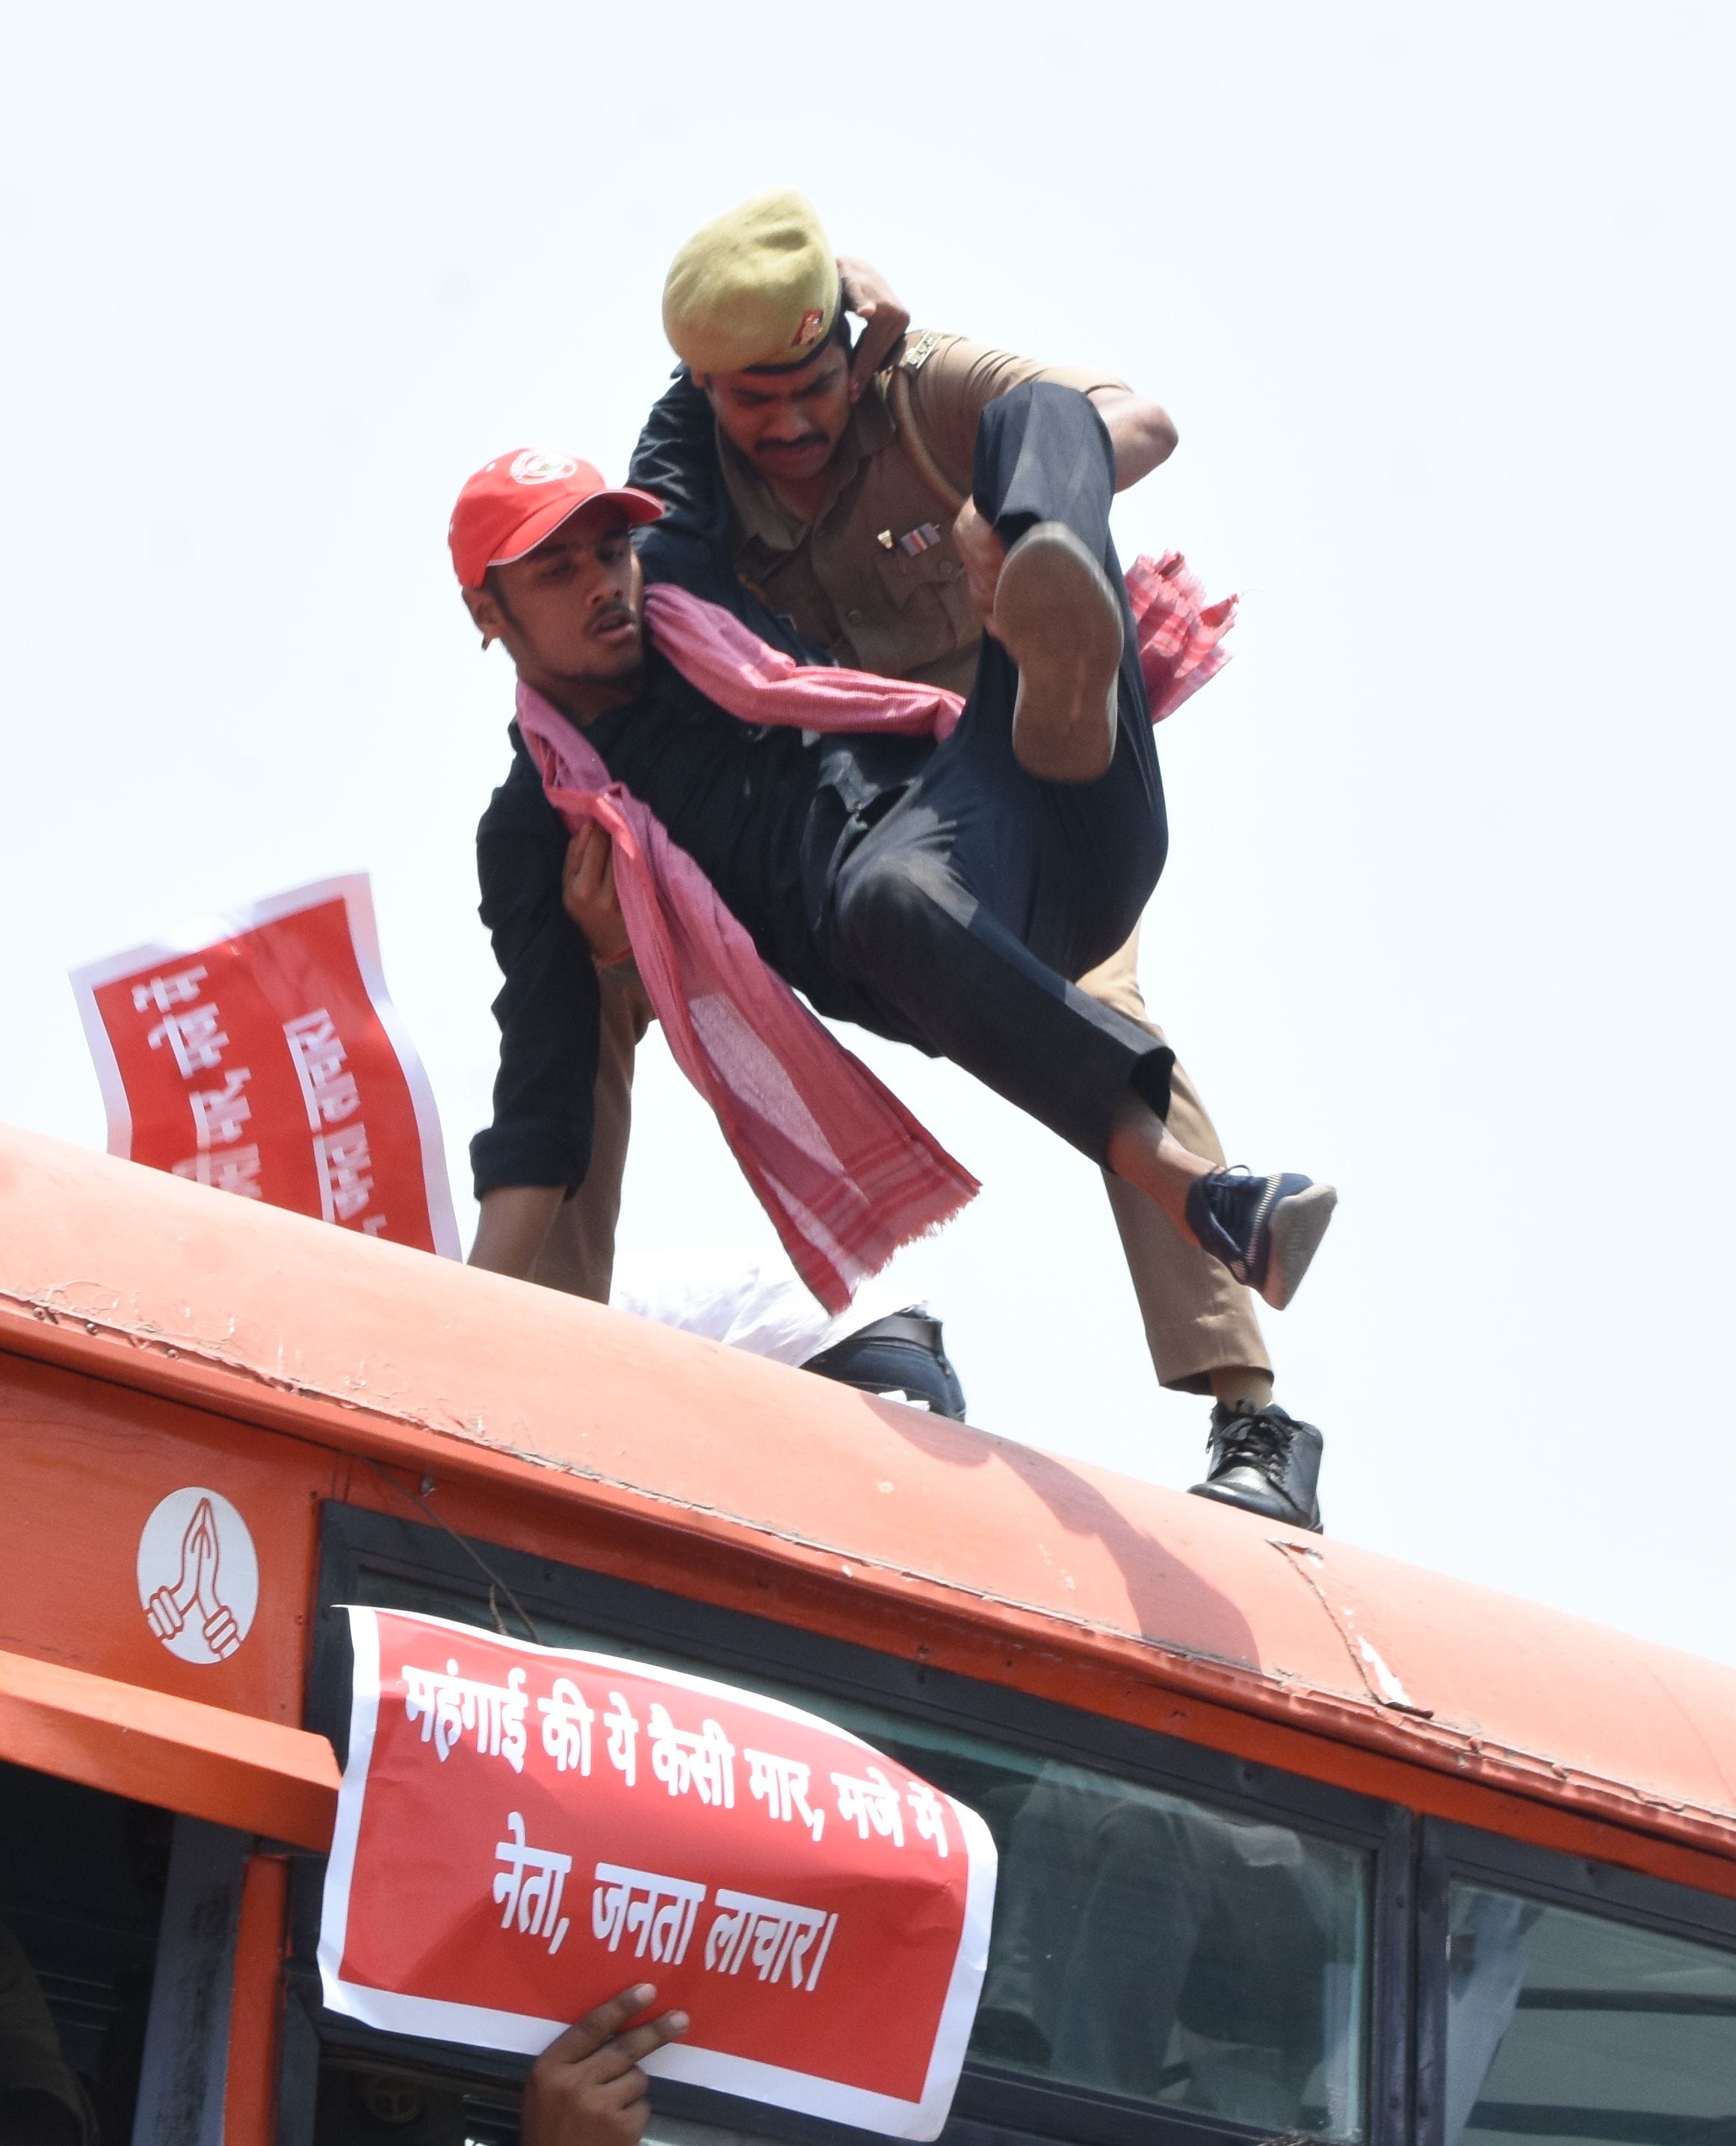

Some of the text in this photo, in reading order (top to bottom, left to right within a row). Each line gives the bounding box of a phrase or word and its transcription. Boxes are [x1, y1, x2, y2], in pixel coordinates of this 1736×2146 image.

[130, 965, 209, 1013] में
[148, 1002, 230, 1079] मजे
[401, 1658, 949, 1858] महंगाई की ये कैसी मार, मजे में
[492, 1811, 572, 1955] नेता,
[592, 1862, 707, 1966] जनता
